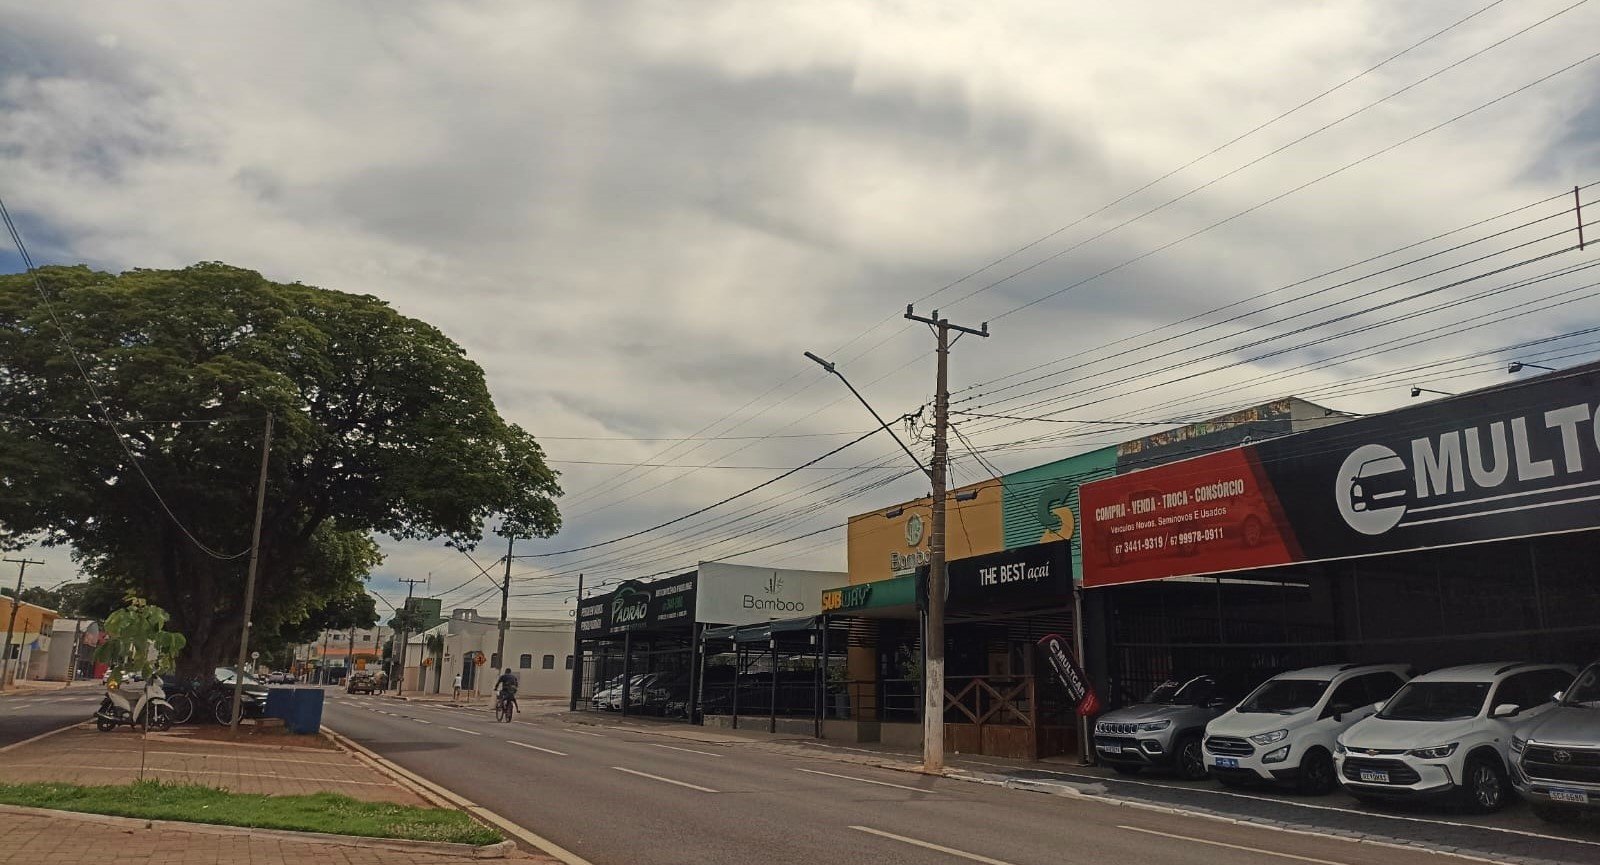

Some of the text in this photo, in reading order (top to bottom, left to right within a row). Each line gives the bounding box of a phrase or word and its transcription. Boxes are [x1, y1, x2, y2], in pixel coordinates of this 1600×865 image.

[1411, 402, 1600, 498] MULT
[1095, 503, 1126, 522] COMPRA
[1131, 497, 1156, 515] VENDA
[1162, 490, 1188, 509] TROCA
[1194, 478, 1244, 503] CONSÓRCIO
[1158, 513, 1193, 526] Seminovos
[1194, 510, 1199, 520] E
[1200, 506, 1227, 518] Usados
[1115, 545, 1122, 554] 67
[1124, 536, 1163, 553] 3441-9319
[1170, 536, 1178, 546] 67
[1179, 527, 1224, 545] 99978-0911
[979, 566, 997, 586] THE
[1000, 562, 1026, 584] BEST
[743, 594, 804, 612] Bamboo
[822, 584, 872, 611] SUBWAY
[1057, 650, 1086, 697] MULTCAR
